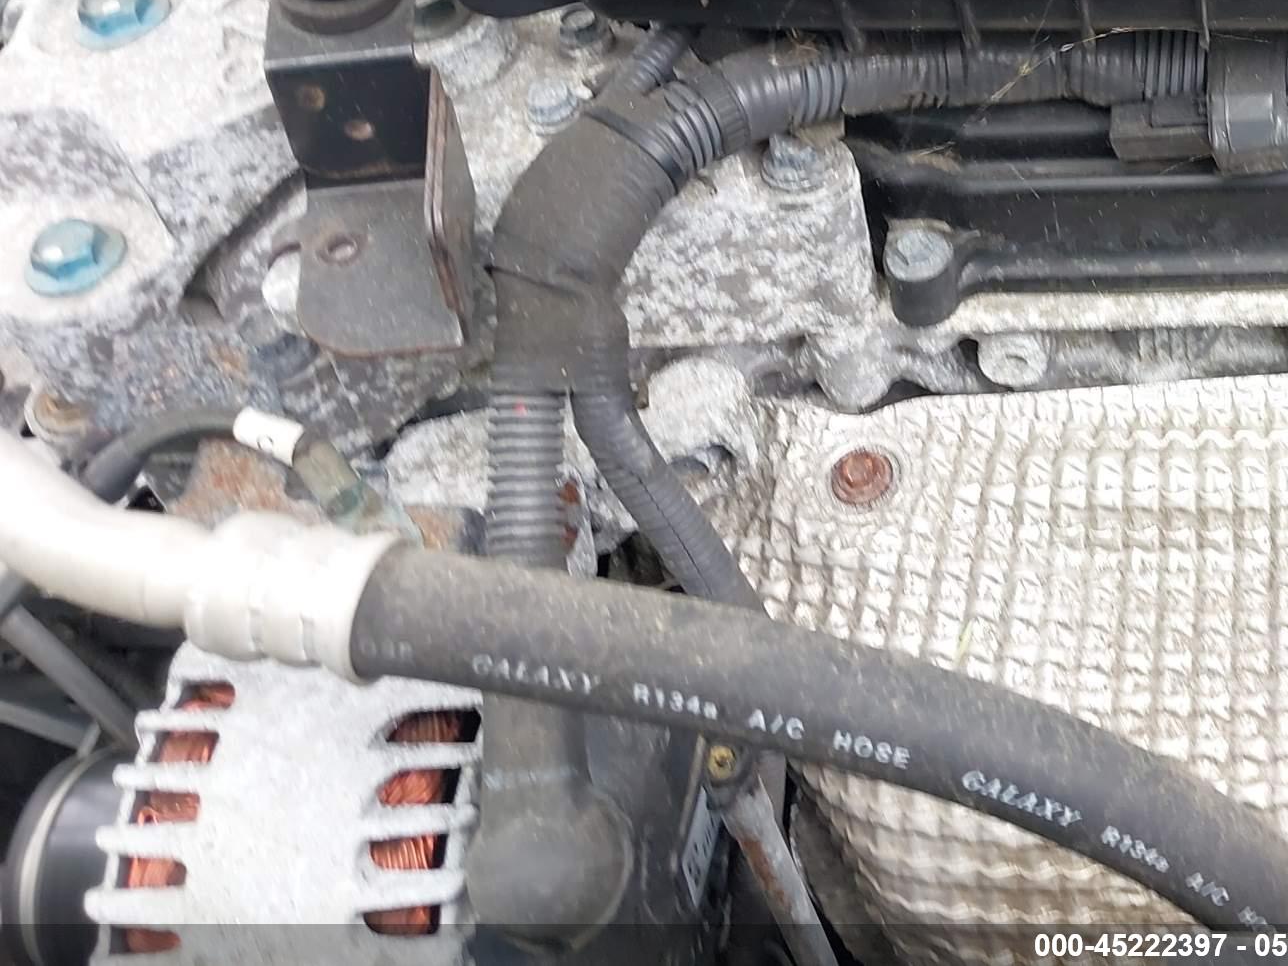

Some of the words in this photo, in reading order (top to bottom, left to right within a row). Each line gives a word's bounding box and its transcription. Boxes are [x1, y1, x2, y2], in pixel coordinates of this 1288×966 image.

[749, 708, 805, 740] A/C
[832, 729, 911, 770] HOSE
[961, 769, 1083, 828] GALAXY
